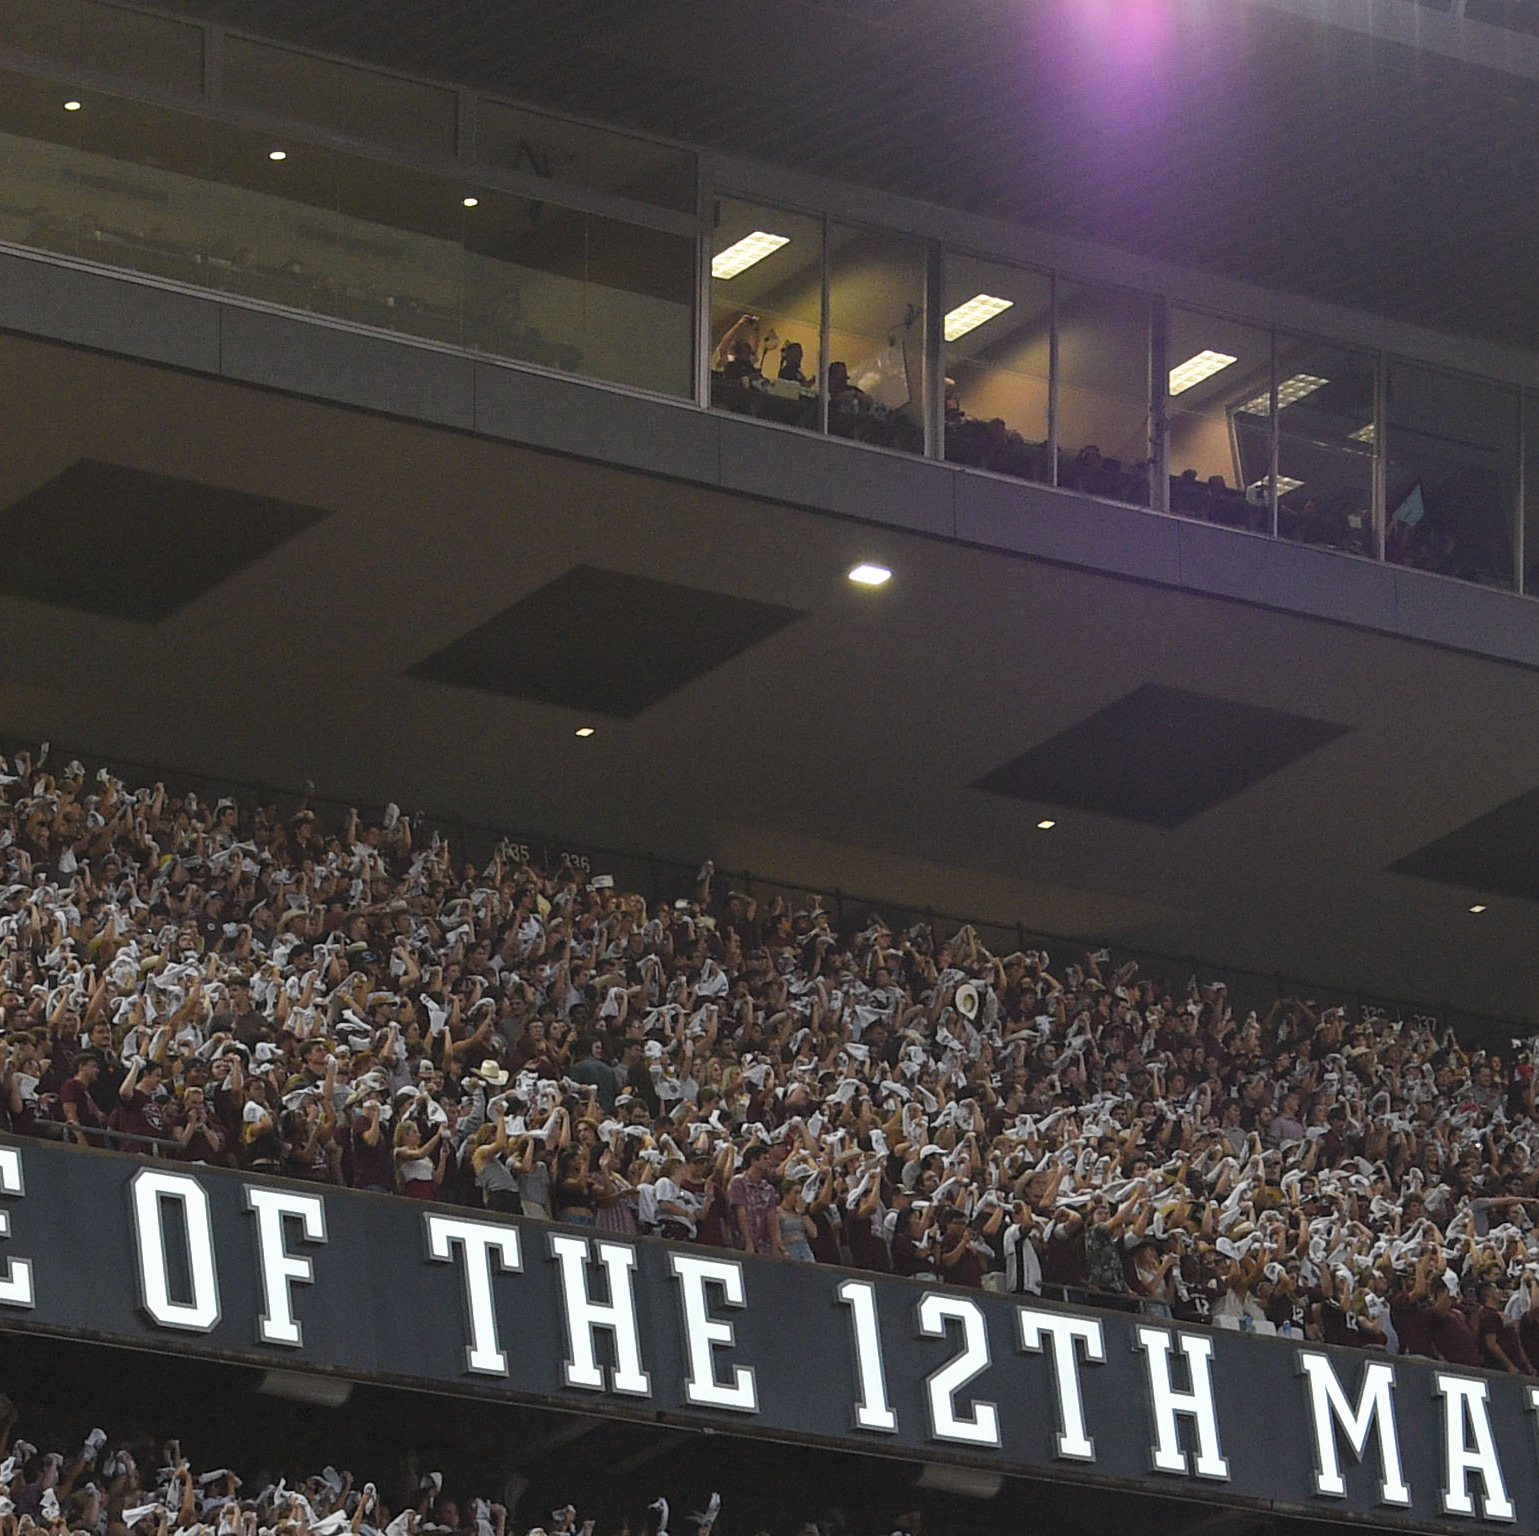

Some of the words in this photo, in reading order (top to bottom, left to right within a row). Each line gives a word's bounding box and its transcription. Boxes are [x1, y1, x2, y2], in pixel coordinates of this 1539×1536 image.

[131, 1168, 327, 1347] OF
[425, 1213, 759, 1412] THE
[838, 1280, 1231, 1481] 12TH
